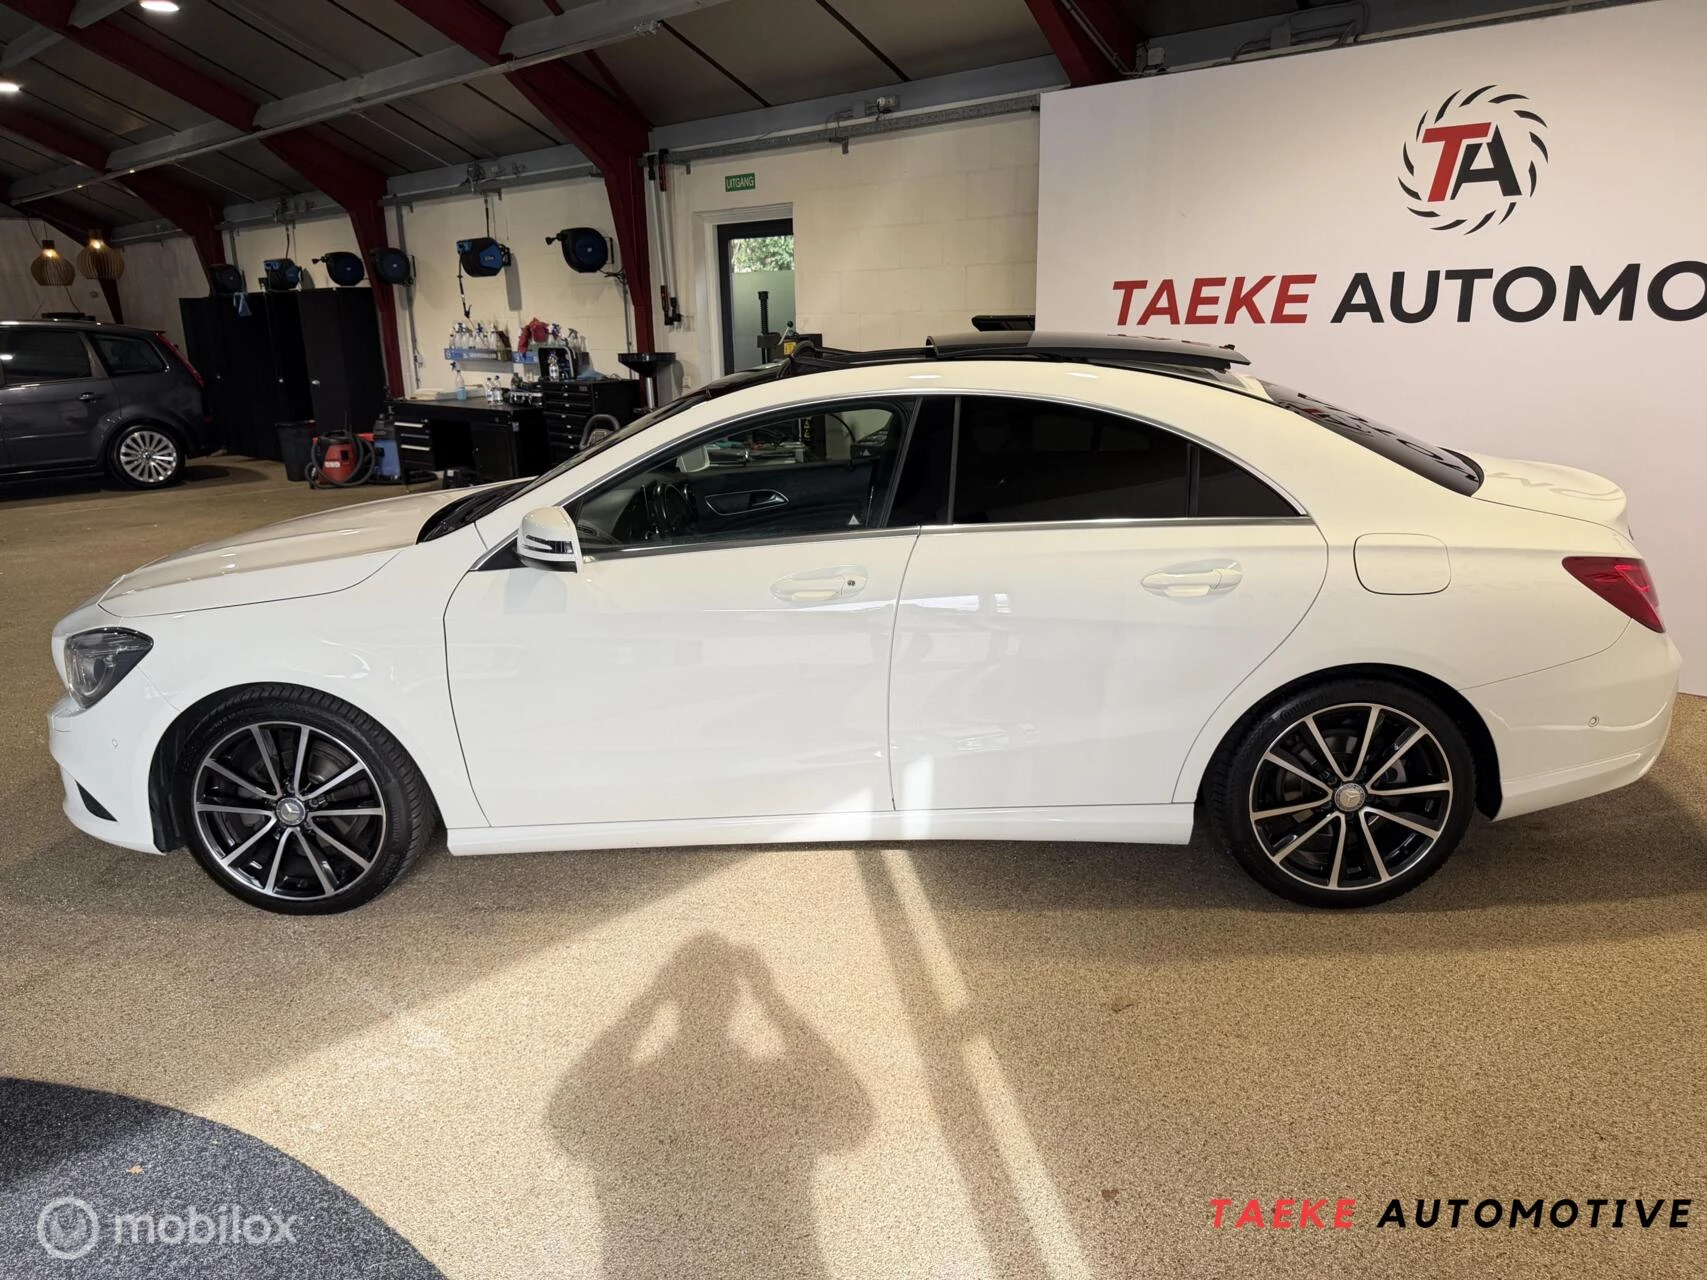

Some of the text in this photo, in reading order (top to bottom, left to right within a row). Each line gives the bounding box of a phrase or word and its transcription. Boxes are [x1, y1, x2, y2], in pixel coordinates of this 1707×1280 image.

[726, 176, 754, 189] UITGANG
[1422, 121, 1523, 203] TA
[1111, 260, 1707, 326] TAEKE AUTOMO
